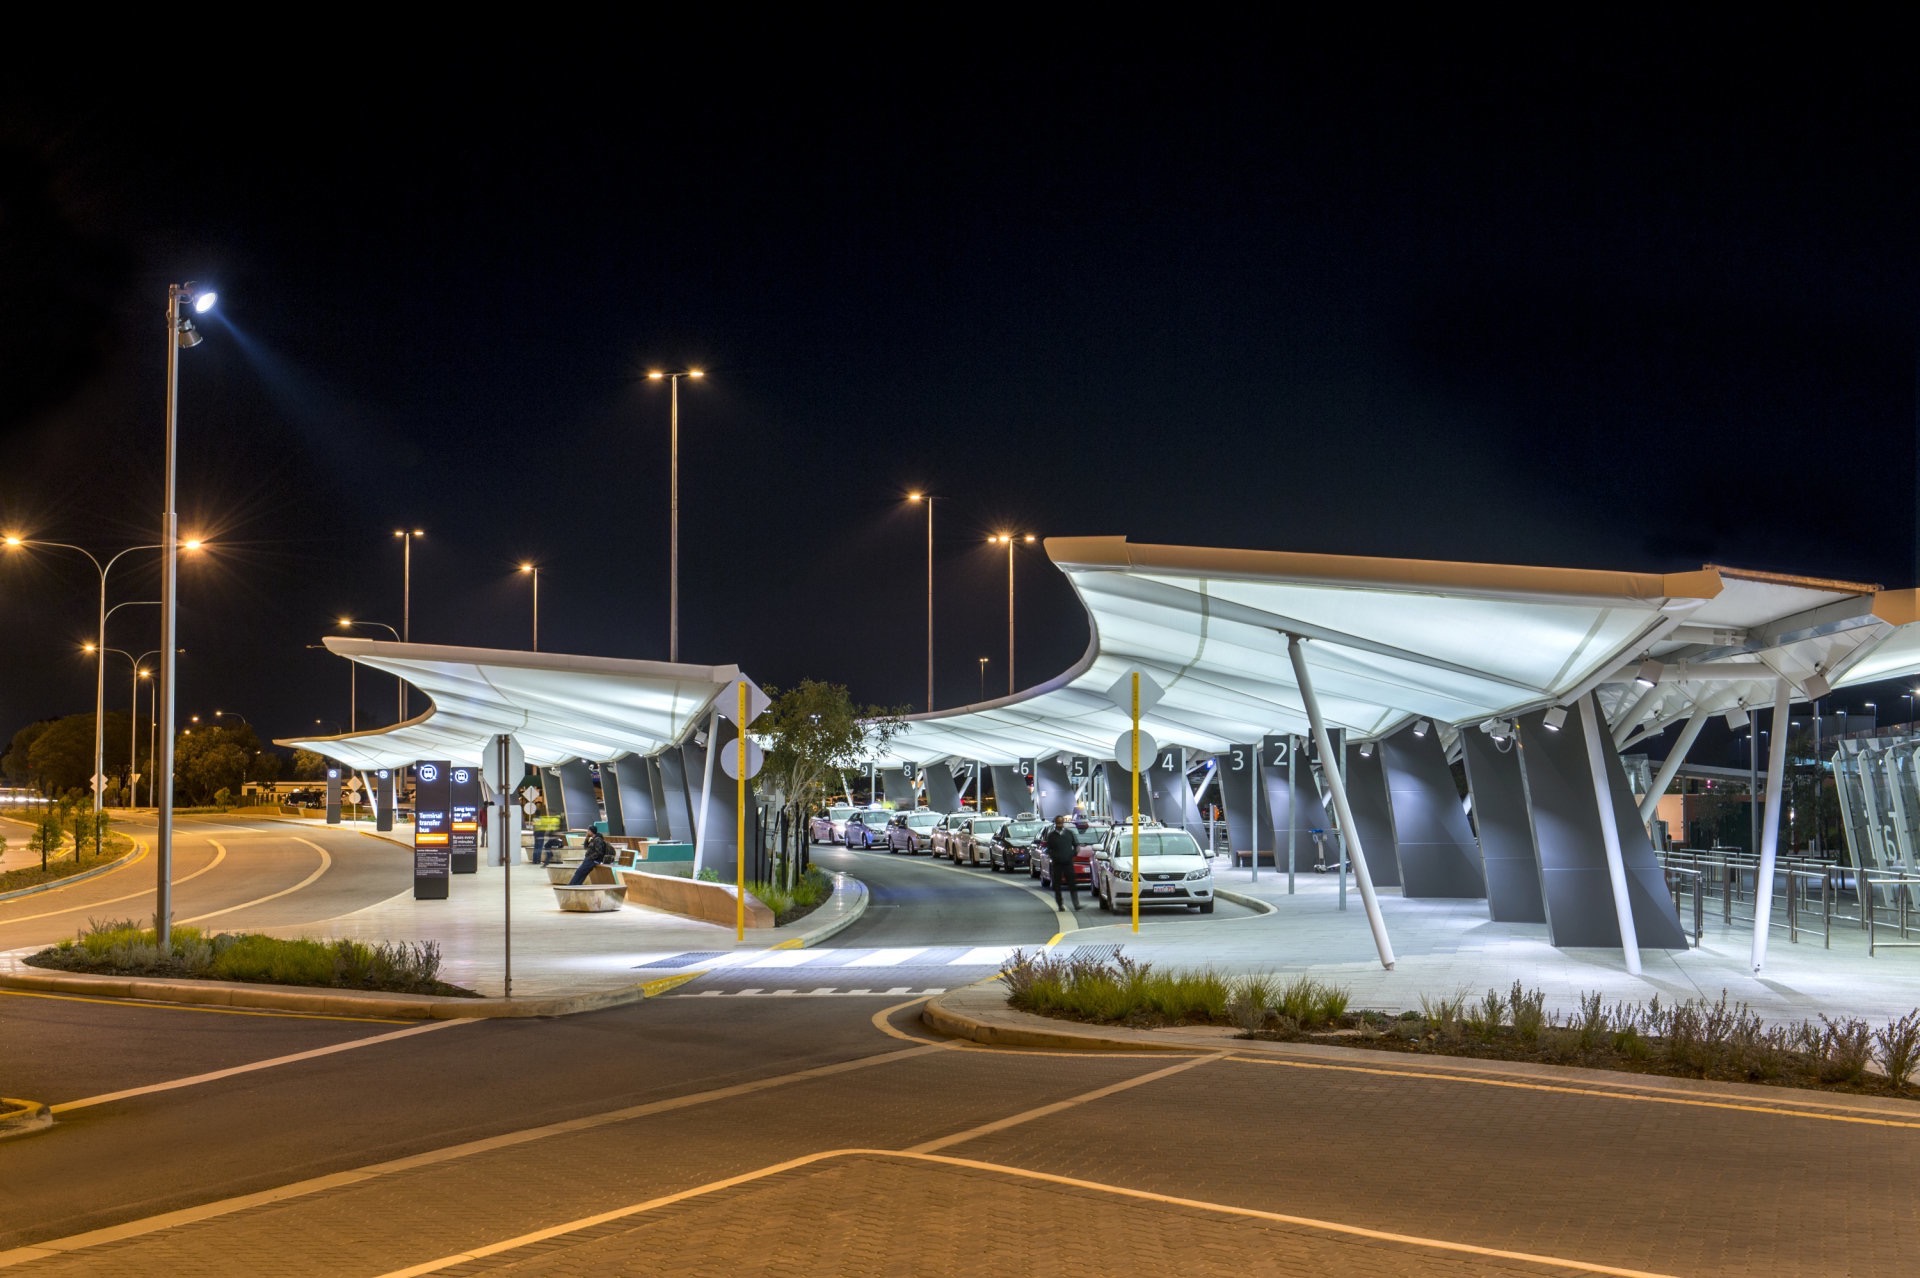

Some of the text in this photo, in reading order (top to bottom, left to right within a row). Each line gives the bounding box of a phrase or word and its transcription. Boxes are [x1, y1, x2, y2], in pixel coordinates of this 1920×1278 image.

[1232, 750, 1244, 771] 3
[1273, 743, 1288, 765] 2
[965, 764, 973, 776] 7
[1021, 761, 1029, 775] 6
[1075, 761, 1083, 776] 5
[1162, 754, 1174, 771] 4
[904, 765, 911, 777] 8
